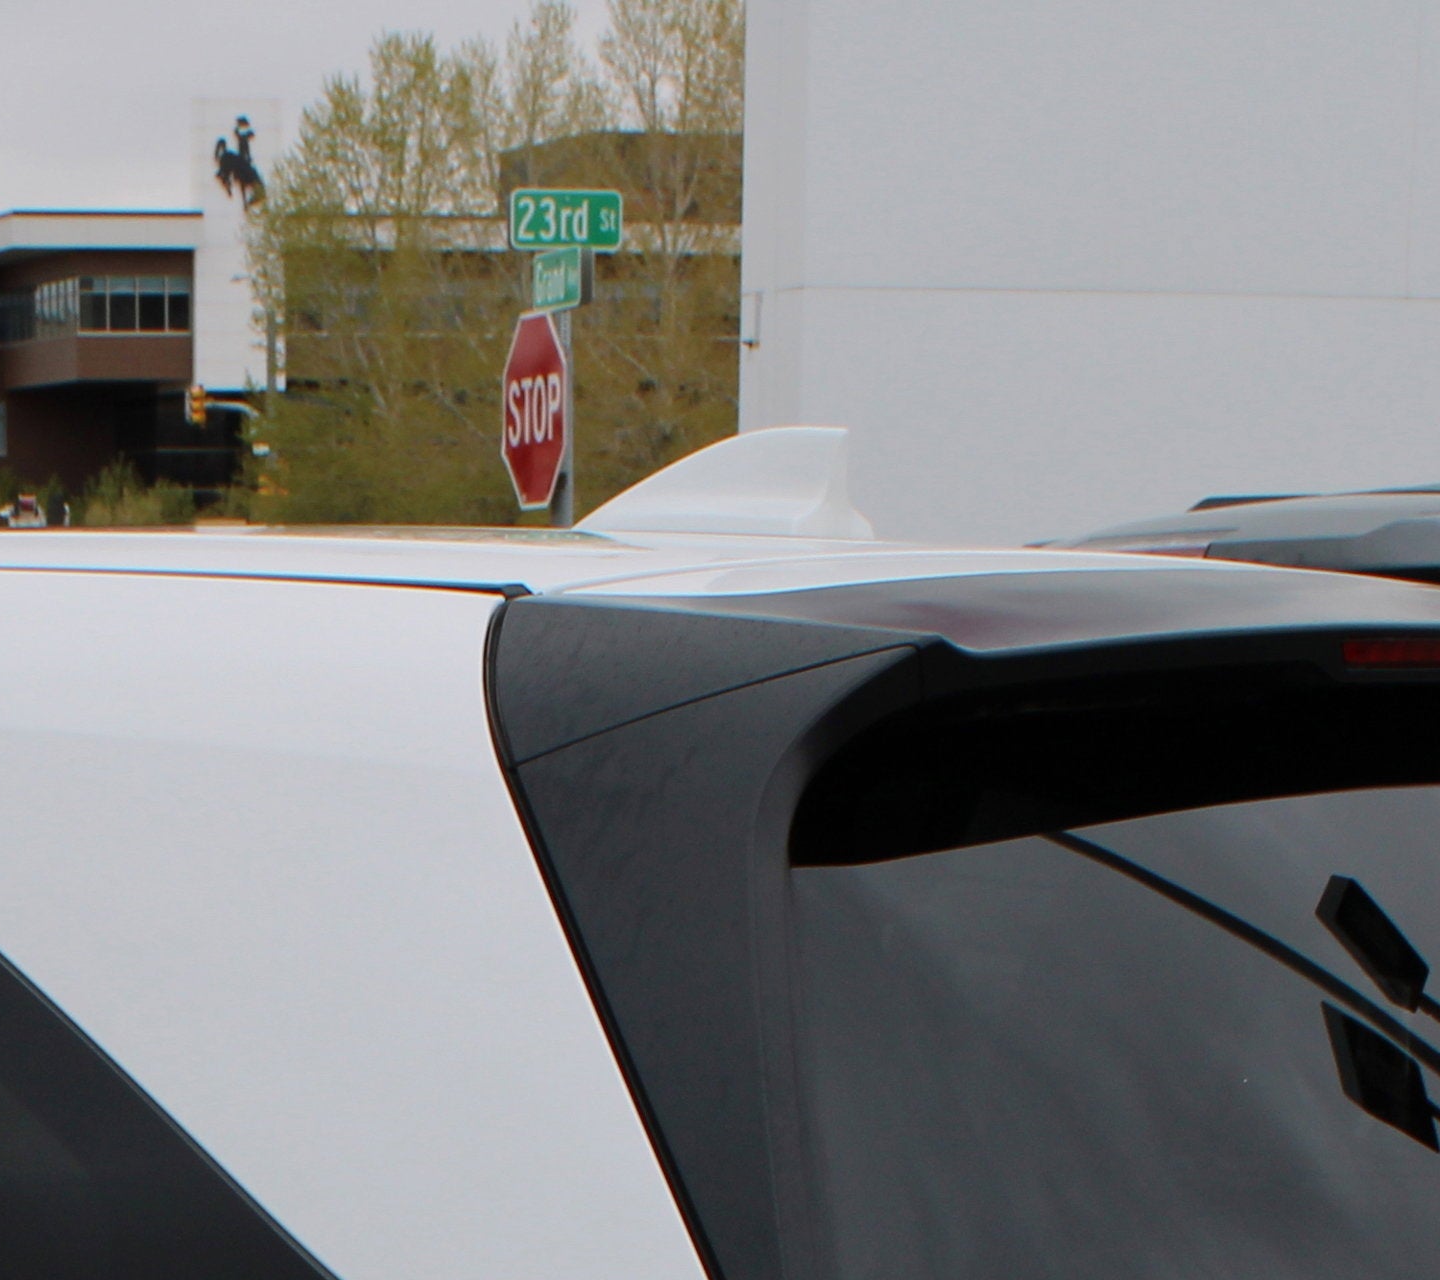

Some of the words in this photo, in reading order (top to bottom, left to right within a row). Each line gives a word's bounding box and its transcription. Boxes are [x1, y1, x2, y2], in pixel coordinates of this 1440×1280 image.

[517, 196, 589, 242] 23rd
[599, 208, 617, 232] St
[508, 372, 561, 448] STOP
